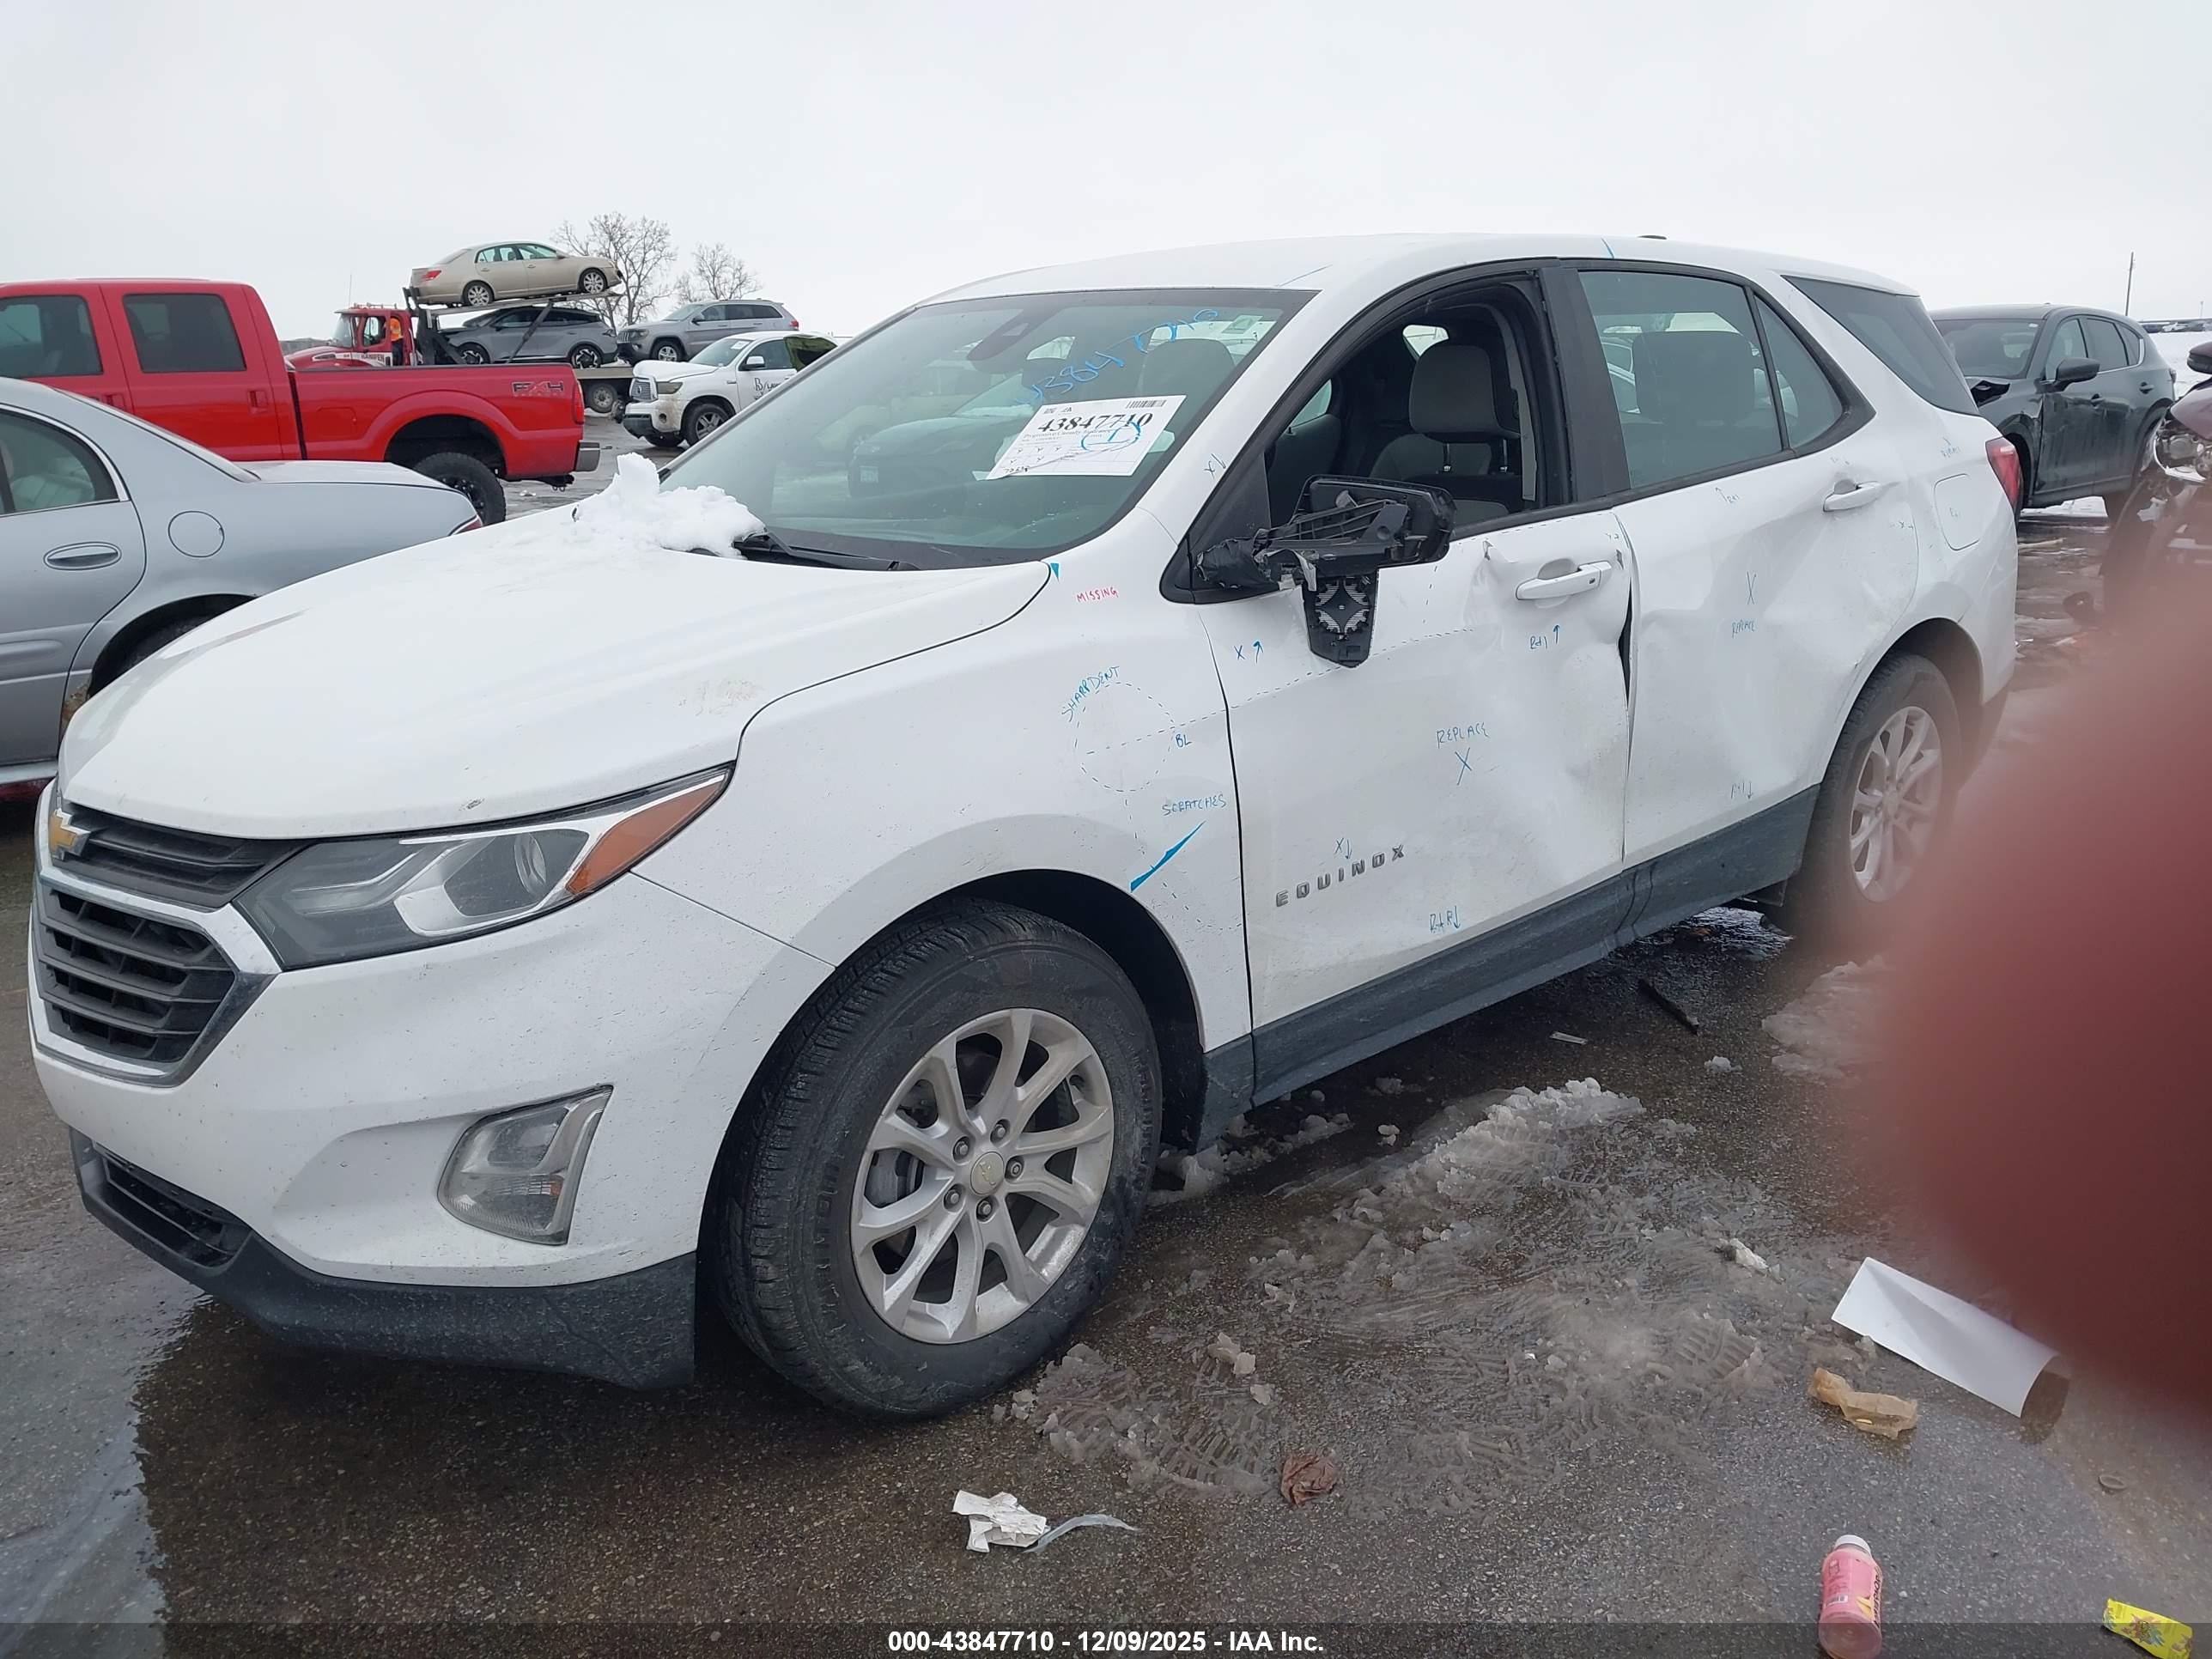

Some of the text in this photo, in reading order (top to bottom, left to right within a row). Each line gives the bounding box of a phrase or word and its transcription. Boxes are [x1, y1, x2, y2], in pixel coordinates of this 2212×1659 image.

[1037, 412, 1153, 433] 43847710
[1075, 586, 1120, 604] MISSING
[1436, 722, 1489, 749] REPLACE
[1275, 844, 1405, 908] EQUINOX
